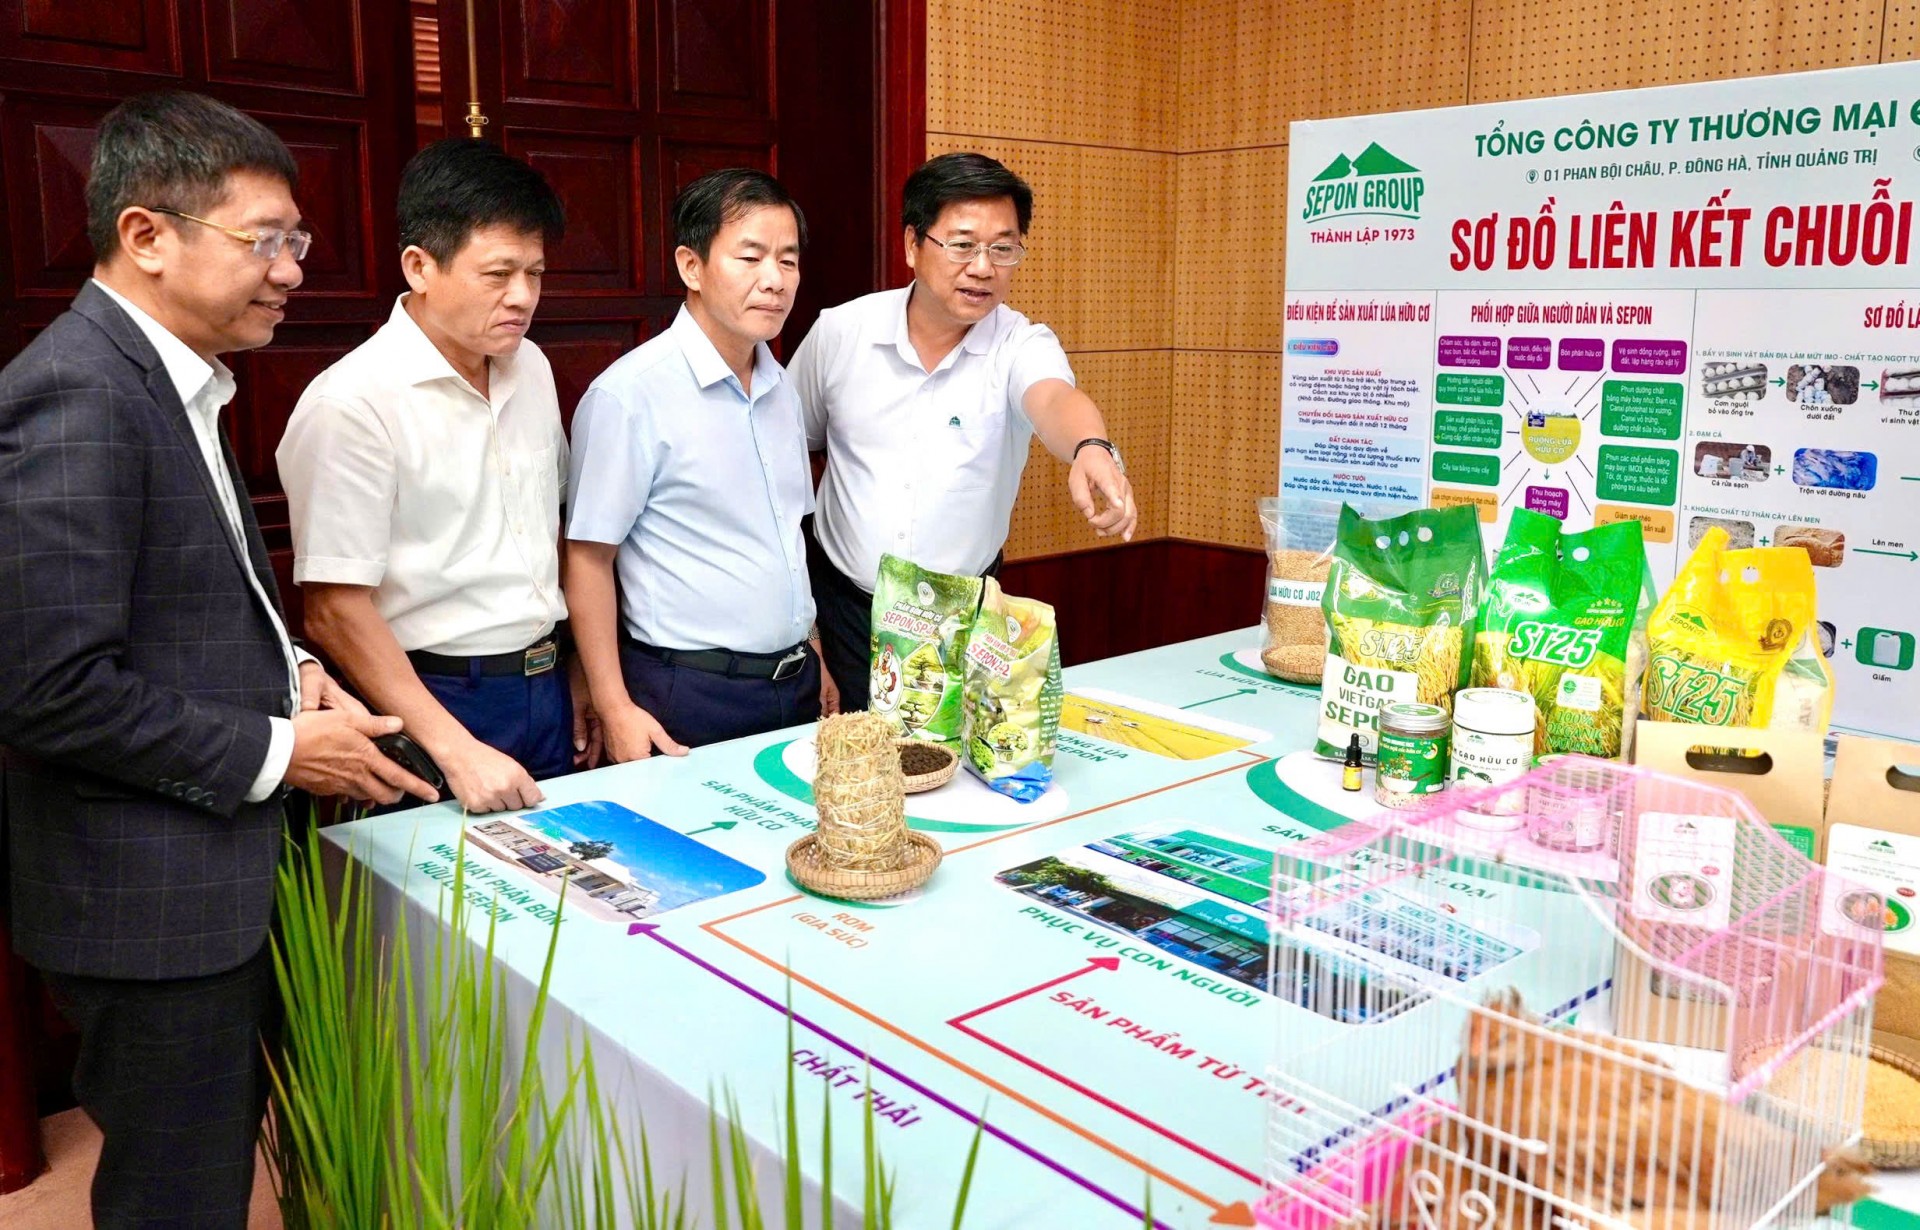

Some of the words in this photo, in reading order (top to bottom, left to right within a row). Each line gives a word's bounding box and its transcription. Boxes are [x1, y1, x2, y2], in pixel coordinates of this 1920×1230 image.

[1475, 120, 1545, 157] TỔNG
[1554, 119, 1638, 150] CÔNG
[1649, 118, 1679, 144] TY
[1689, 107, 1821, 142] THƯƠNG
[1833, 100, 1897, 137] MẠI
[1544, 168, 1559, 182] 01
[1564, 166, 1597, 181] PHAN
[1601, 161, 1621, 181] BỘI
[1625, 159, 1664, 177] CHÂU,
[1669, 161, 1681, 174] P.
[1685, 157, 1723, 173] ĐÔNG
[1727, 155, 1751, 172] HÀ,
[1758, 152, 1791, 169] TỈNH
[1796, 148, 1848, 167] QUẢNG
[1853, 148, 1877, 166] TRỊ
[1303, 181, 1358, 220] SEPON
[1364, 177, 1424, 212] GROUP
[1311, 228, 1352, 243] THÀNH
[1356, 227, 1380, 245] LẬP
[1384, 228, 1415, 241] 1973
[1450, 212, 1498, 271] SƠ
[1507, 197, 1556, 270] ĐỒ
[1569, 201, 1657, 269] LIÊN
[1669, 189, 1751, 268] KẾT
[1764, 177, 1913, 267] CHUỖI
[1306, 303, 1324, 324] KIỆN
[1327, 298, 1337, 321] ĐỂ
[1339, 300, 1355, 321] SẢN
[1357, 299, 1378, 321] XUẤT
[1381, 301, 1396, 321] LÚA
[1399, 301, 1415, 322] HỮU
[1418, 303, 1431, 322] CƠ
[1471, 299, 1493, 322] PHỐI
[1496, 304, 1514, 327] HỢP
[1517, 302, 1539, 323] GIỮA
[1543, 301, 1573, 323] NGƯỜI
[1576, 302, 1597, 324] DÂN
[1600, 302, 1613, 324] VÀ
[1617, 306, 1652, 324] SEPON
[1864, 305, 1883, 328] SƠ
[1886, 300, 1904, 328] ĐỒ
[1872, 539, 1885, 547] Lên
[1293, 589, 1303, 599] CƠ
[1306, 591, 1320, 601] J02
[883, 611, 914, 629] SEPON
[1508, 621, 1602, 668] ST25
[1343, 666, 1394, 692] GẠO
[701, 780, 737, 795] SẢN
[731, 792, 781, 813] PHẨM
[723, 805, 762, 821] HỮU
[757, 819, 789, 831] CƠ
[485, 879, 535, 906] PHÂN
[790, 912, 829, 931] (GIA
[825, 927, 868, 948] SÚC)
[831, 912, 875, 932] RƠM
[1019, 906, 1084, 934] PHỤC
[1083, 931, 1120, 950] VỤ
[1118, 947, 1174, 971] CON
[1171, 968, 1261, 1007] NGƯỜI
[1049, 991, 1111, 1019] SẢN
[1105, 1017, 1197, 1059] PHẨM
[1197, 1055, 1249, 1080] TỪ
[791, 1048, 860, 1088] CHẤT
[852, 1086, 922, 1129] THẢI
